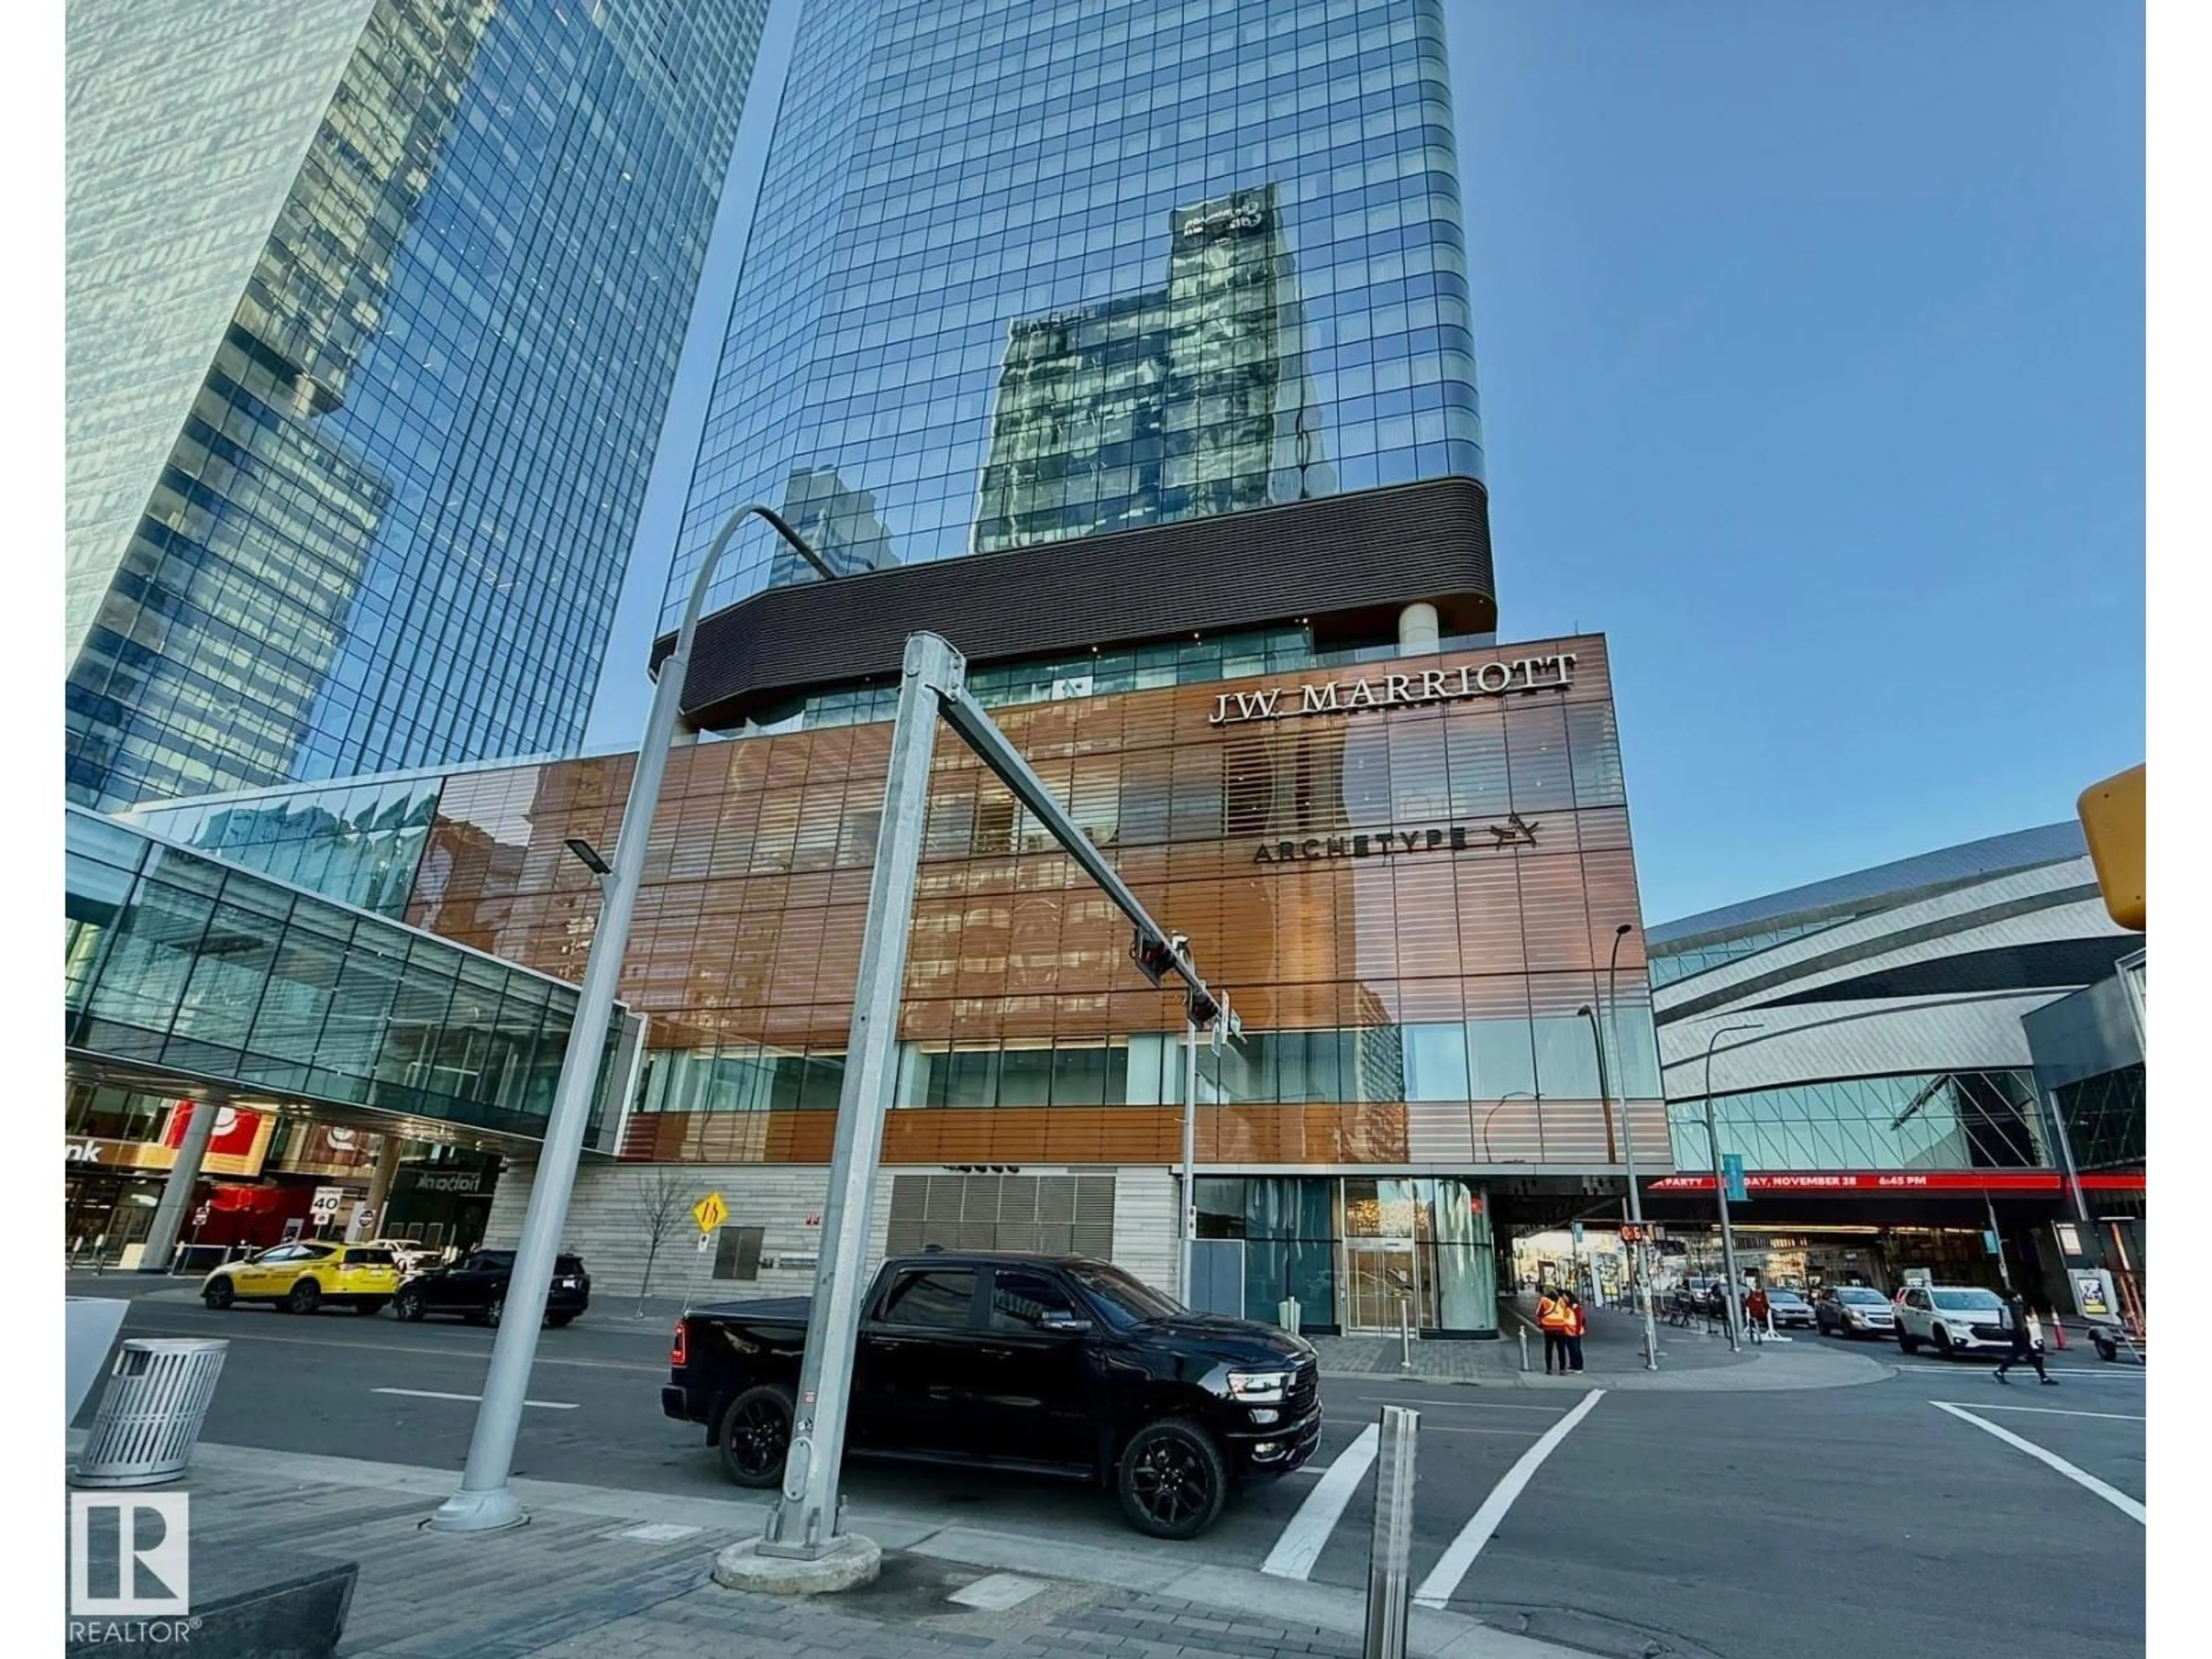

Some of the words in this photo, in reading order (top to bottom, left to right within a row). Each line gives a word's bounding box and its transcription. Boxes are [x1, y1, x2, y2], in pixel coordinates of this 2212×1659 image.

[1209, 687, 1282, 723] JW
[1301, 653, 1577, 713] MARRIOTT
[1254, 826, 1467, 862] ARCHETYPE
[1665, 1177, 1703, 1186] PARTY
[1774, 1176, 1840, 1185] NOVEMBER
[1906, 1176, 1926, 1185] PM
[313, 1197, 338, 1210] 40
